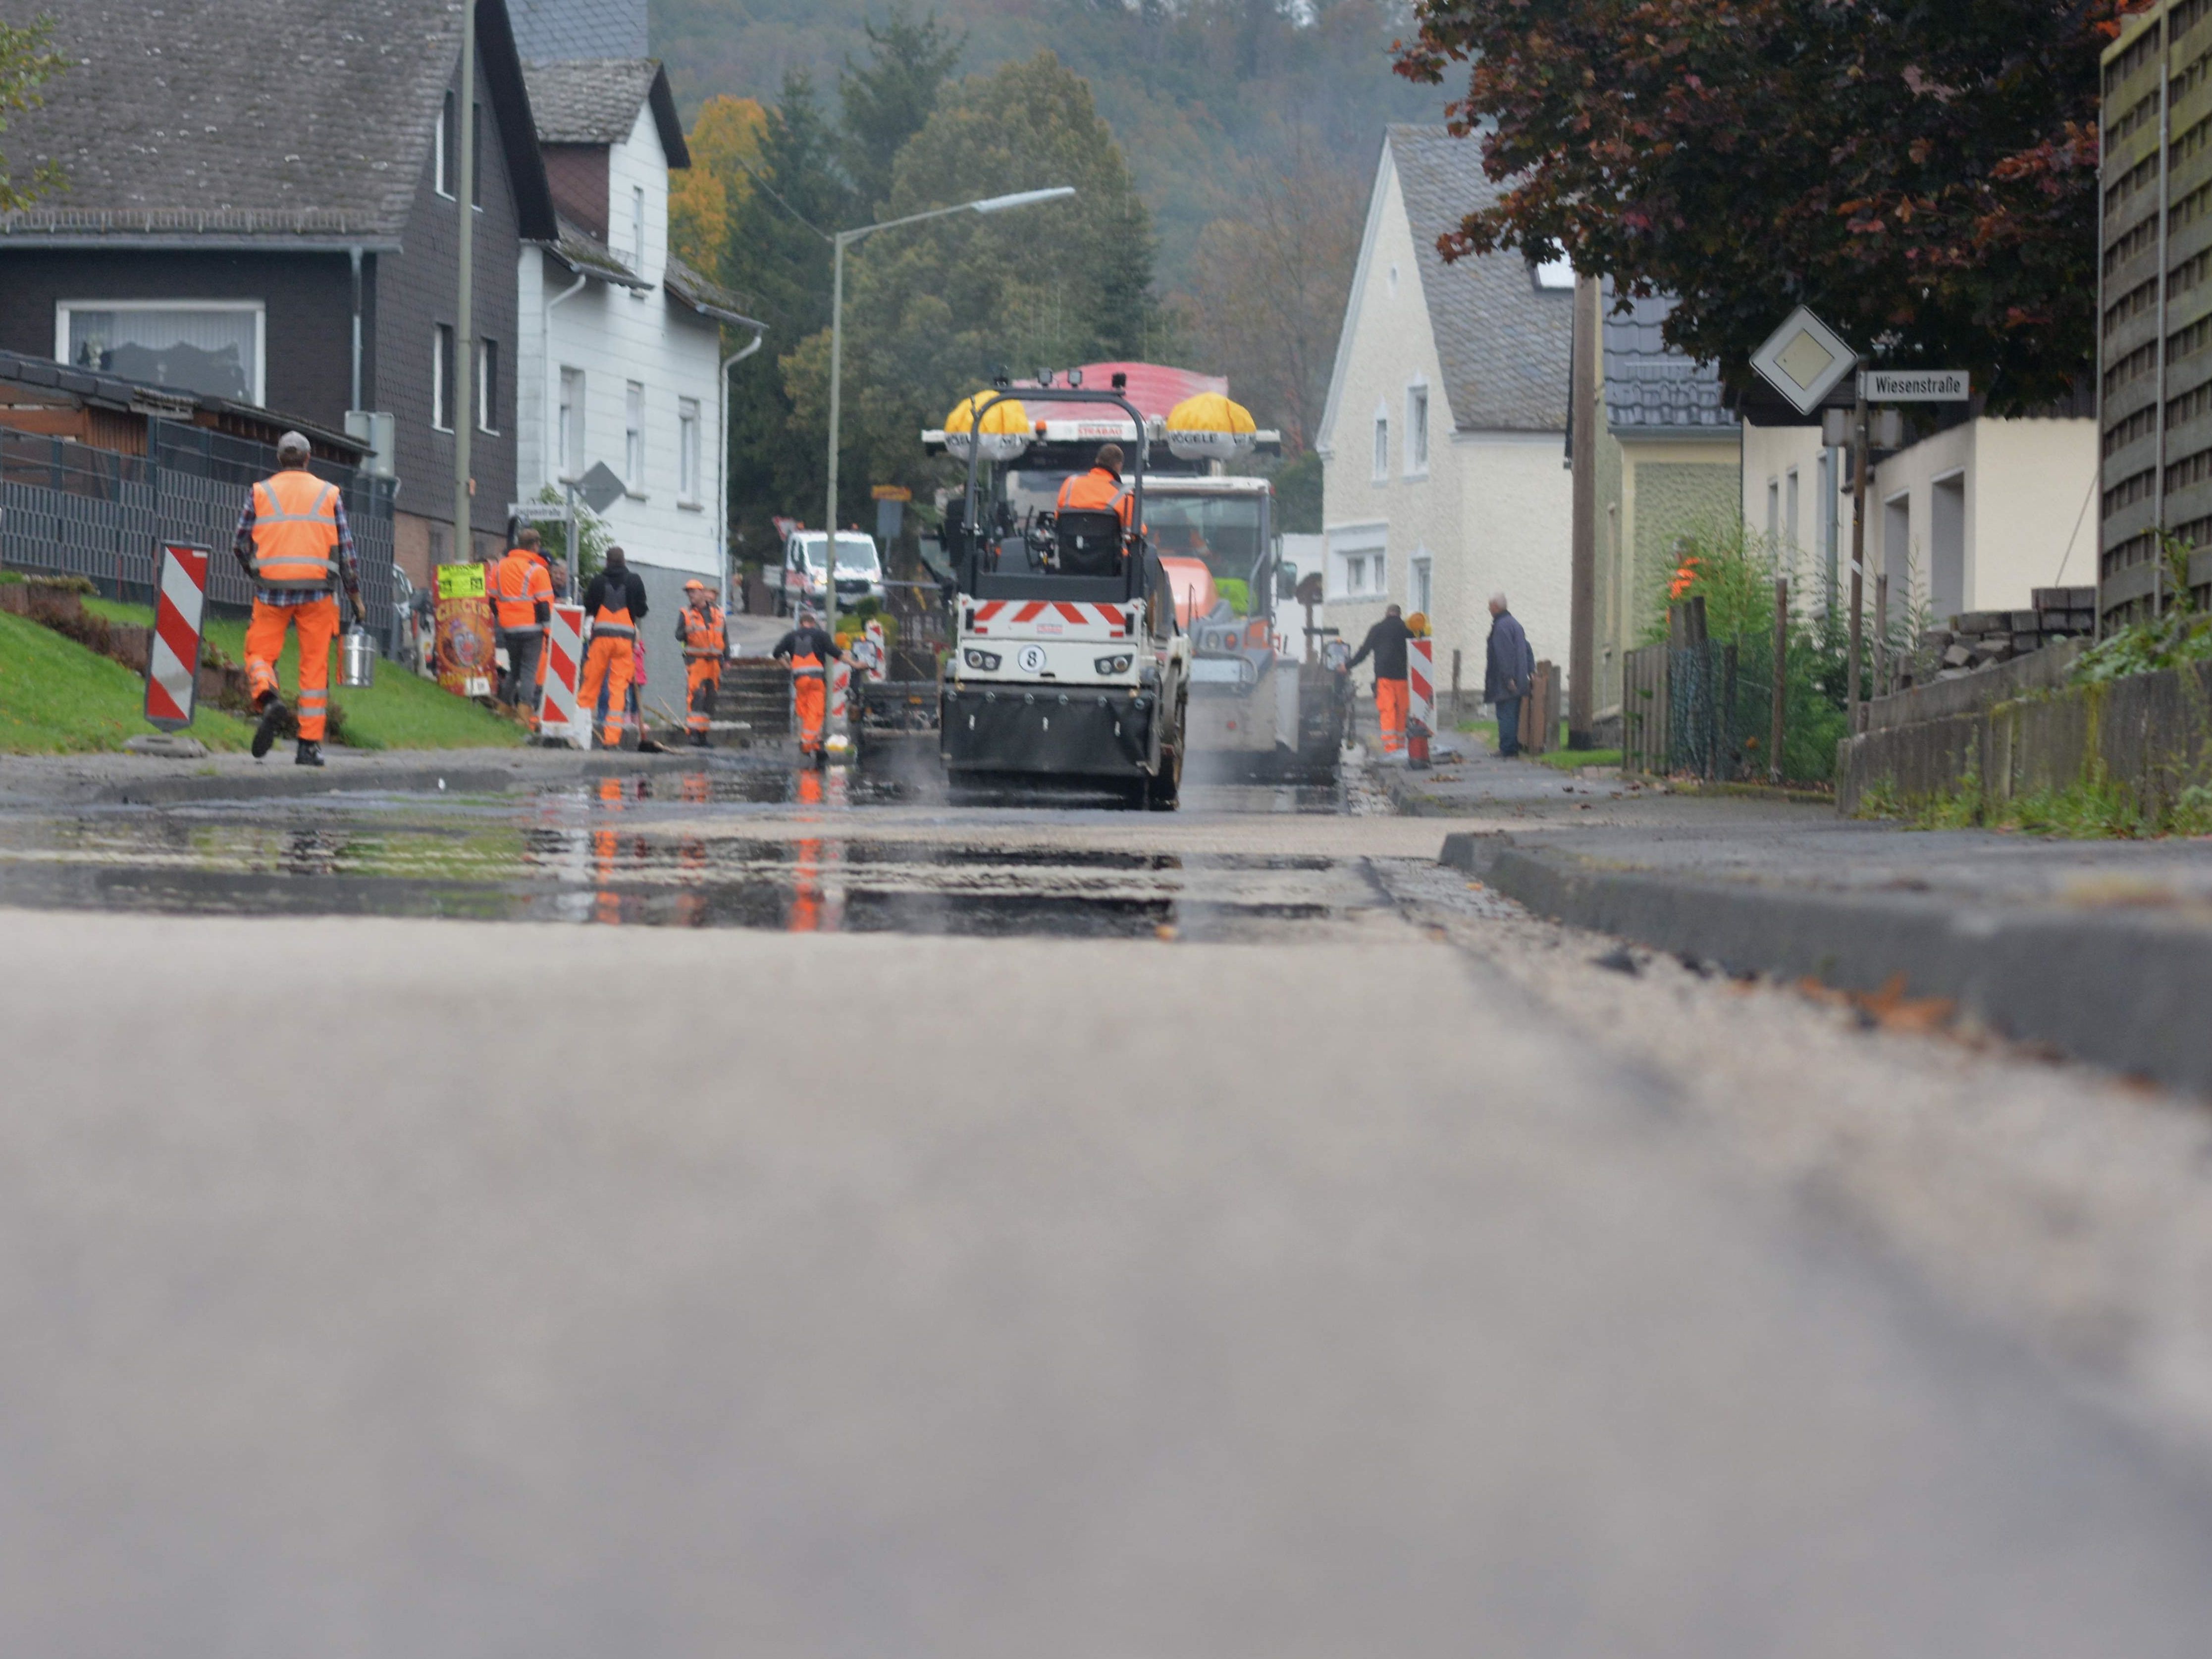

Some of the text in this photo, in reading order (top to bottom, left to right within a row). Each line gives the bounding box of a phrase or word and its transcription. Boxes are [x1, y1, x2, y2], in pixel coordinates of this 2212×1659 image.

[1875, 375, 1960, 394] Wiesenstraße
[436, 599, 490, 622] CIRCUS
[1027, 650, 1037, 668] 8
